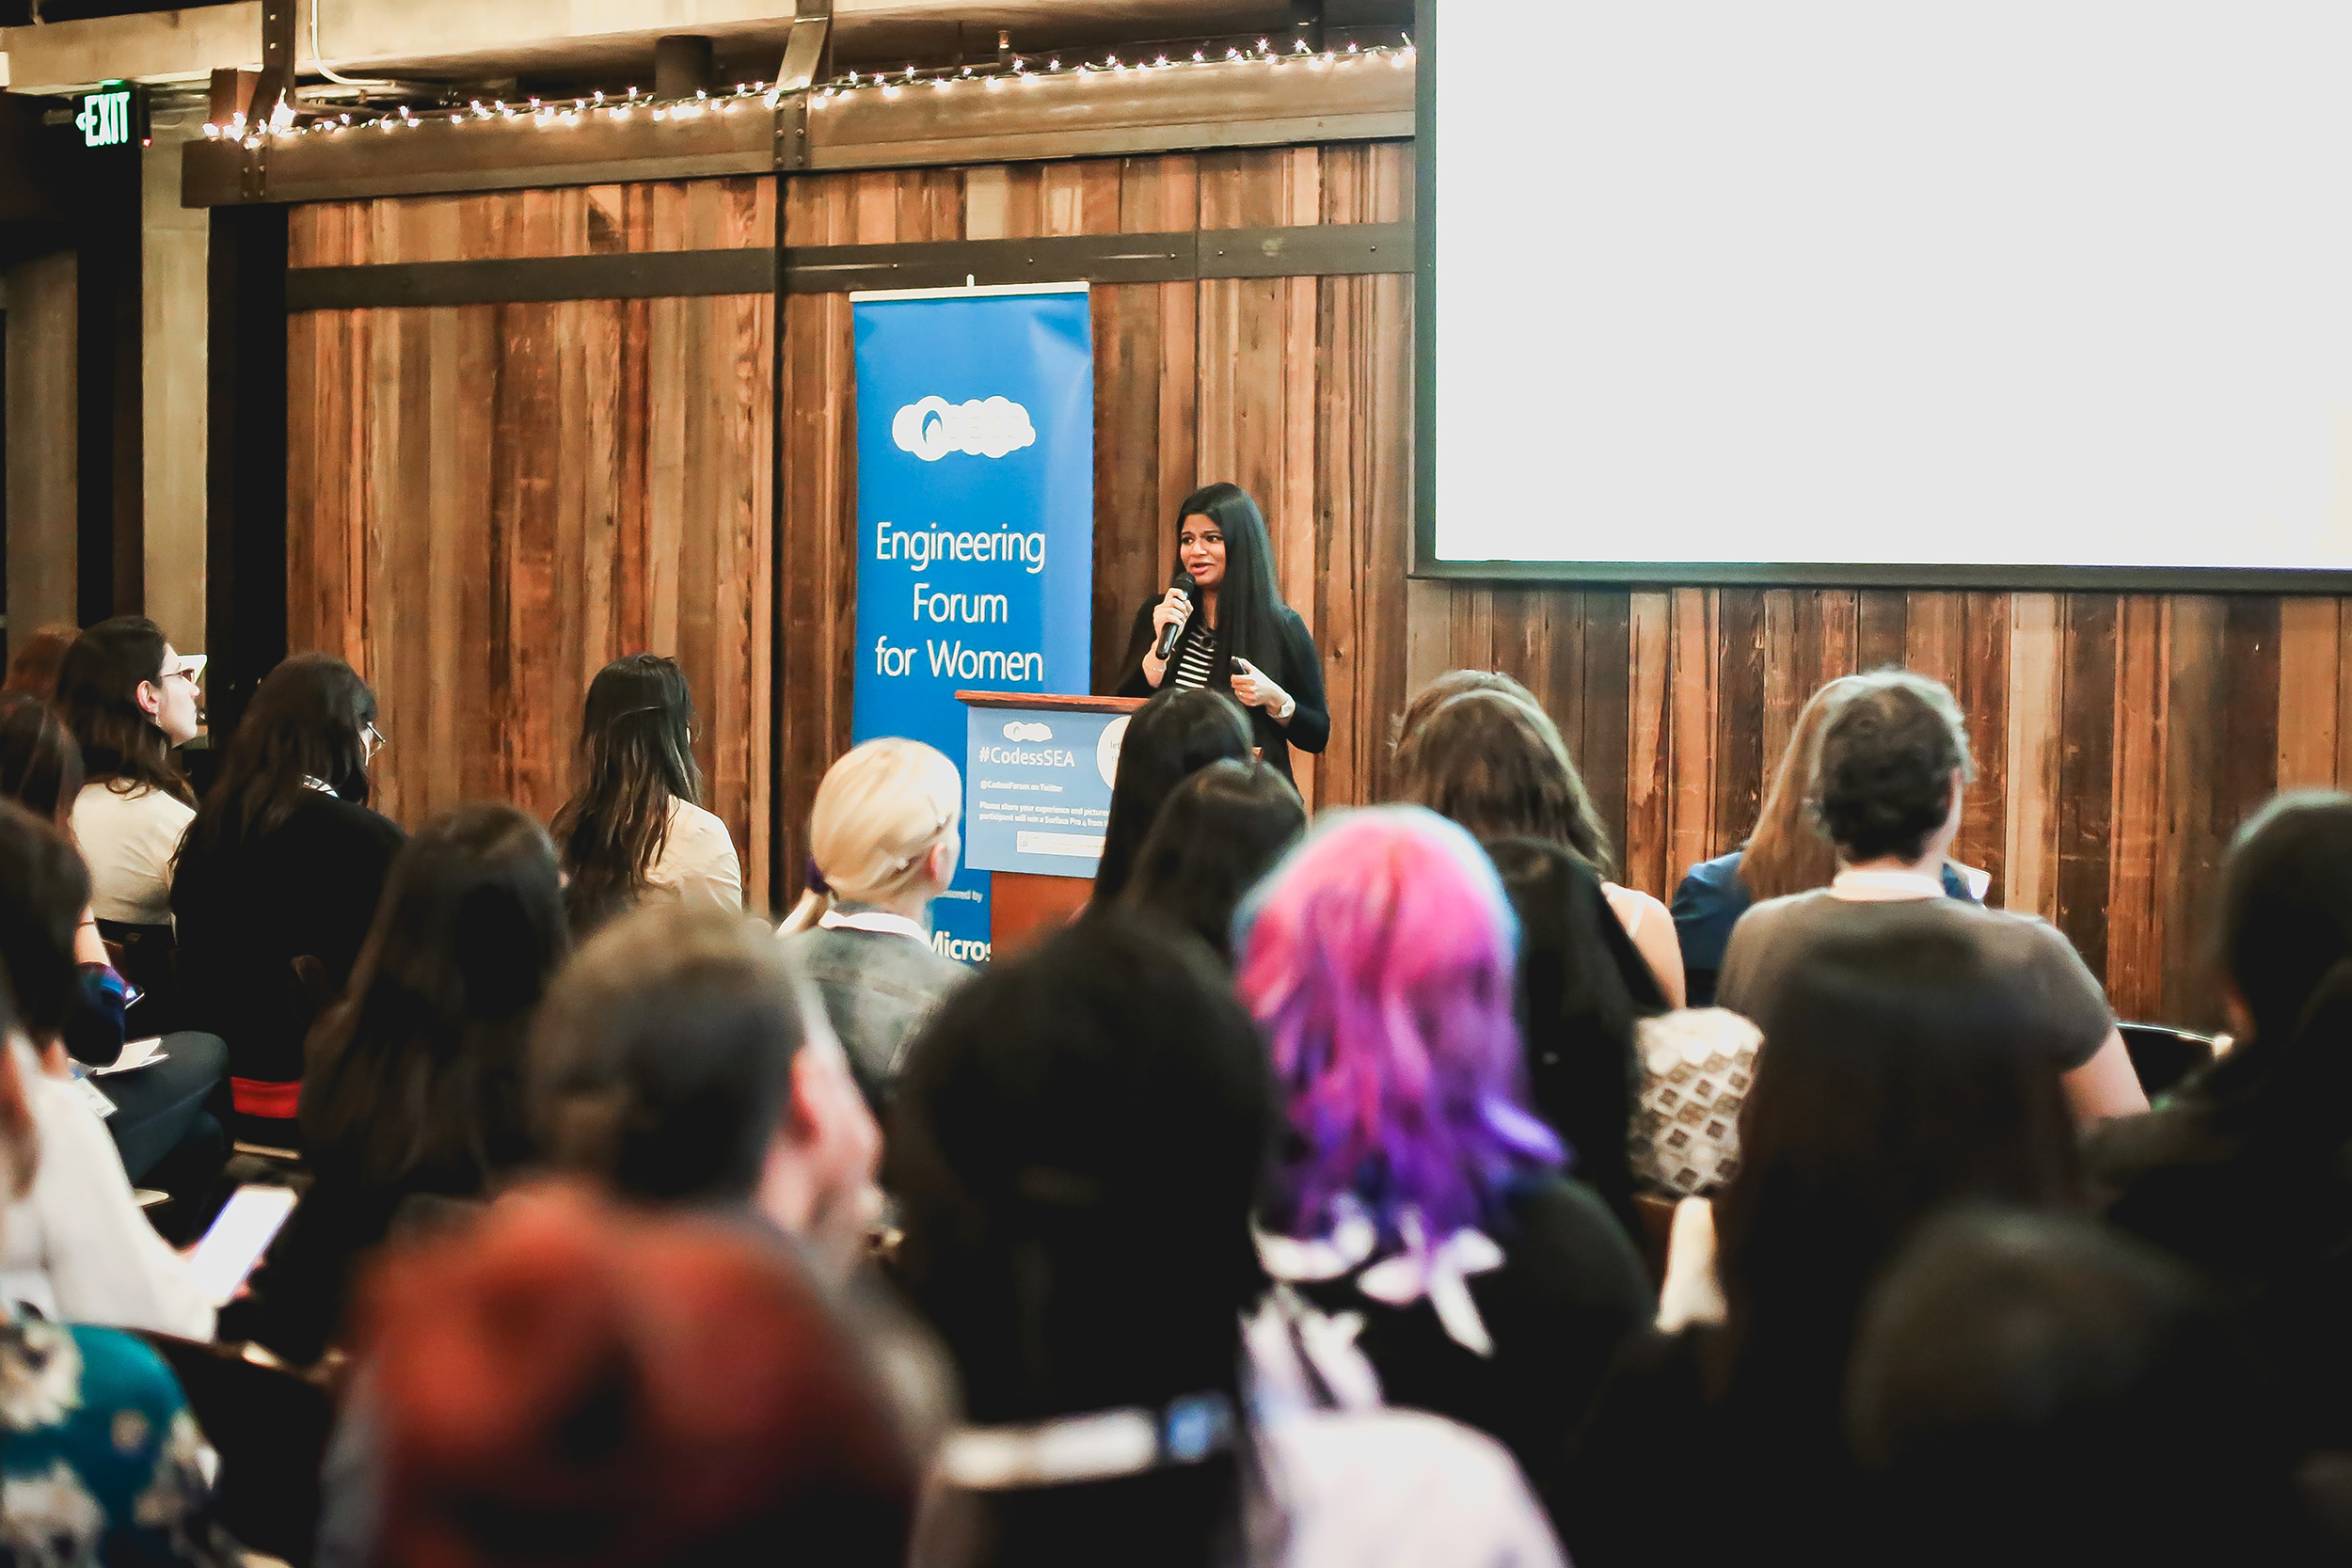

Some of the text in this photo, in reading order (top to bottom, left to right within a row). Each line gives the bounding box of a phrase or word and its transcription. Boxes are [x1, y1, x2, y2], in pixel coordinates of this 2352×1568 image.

[85, 91, 131, 148] EXIT
[876, 521, 1046, 574] Engineering
[913, 582, 1009, 624] Forum
[875, 635, 1044, 682] for Women
[978, 746, 1076, 768] #CodessSEA
[1040, 783, 1064, 793] Twitter
[979, 800, 1000, 811] Please
[1000, 802, 1019, 812] share
[1019, 805, 1034, 814] your
[1035, 805, 1070, 815] experience
[1070, 807, 1083, 816] and
[979, 813, 1014, 822] participant
[1014, 814, 1026, 823] will
[1044, 816, 1070, 825] Surface
[1070, 817, 1082, 826] Pro
[1082, 819, 1088, 828] 4
[1088, 817, 1104, 827] from
[972, 889, 984, 903] by
